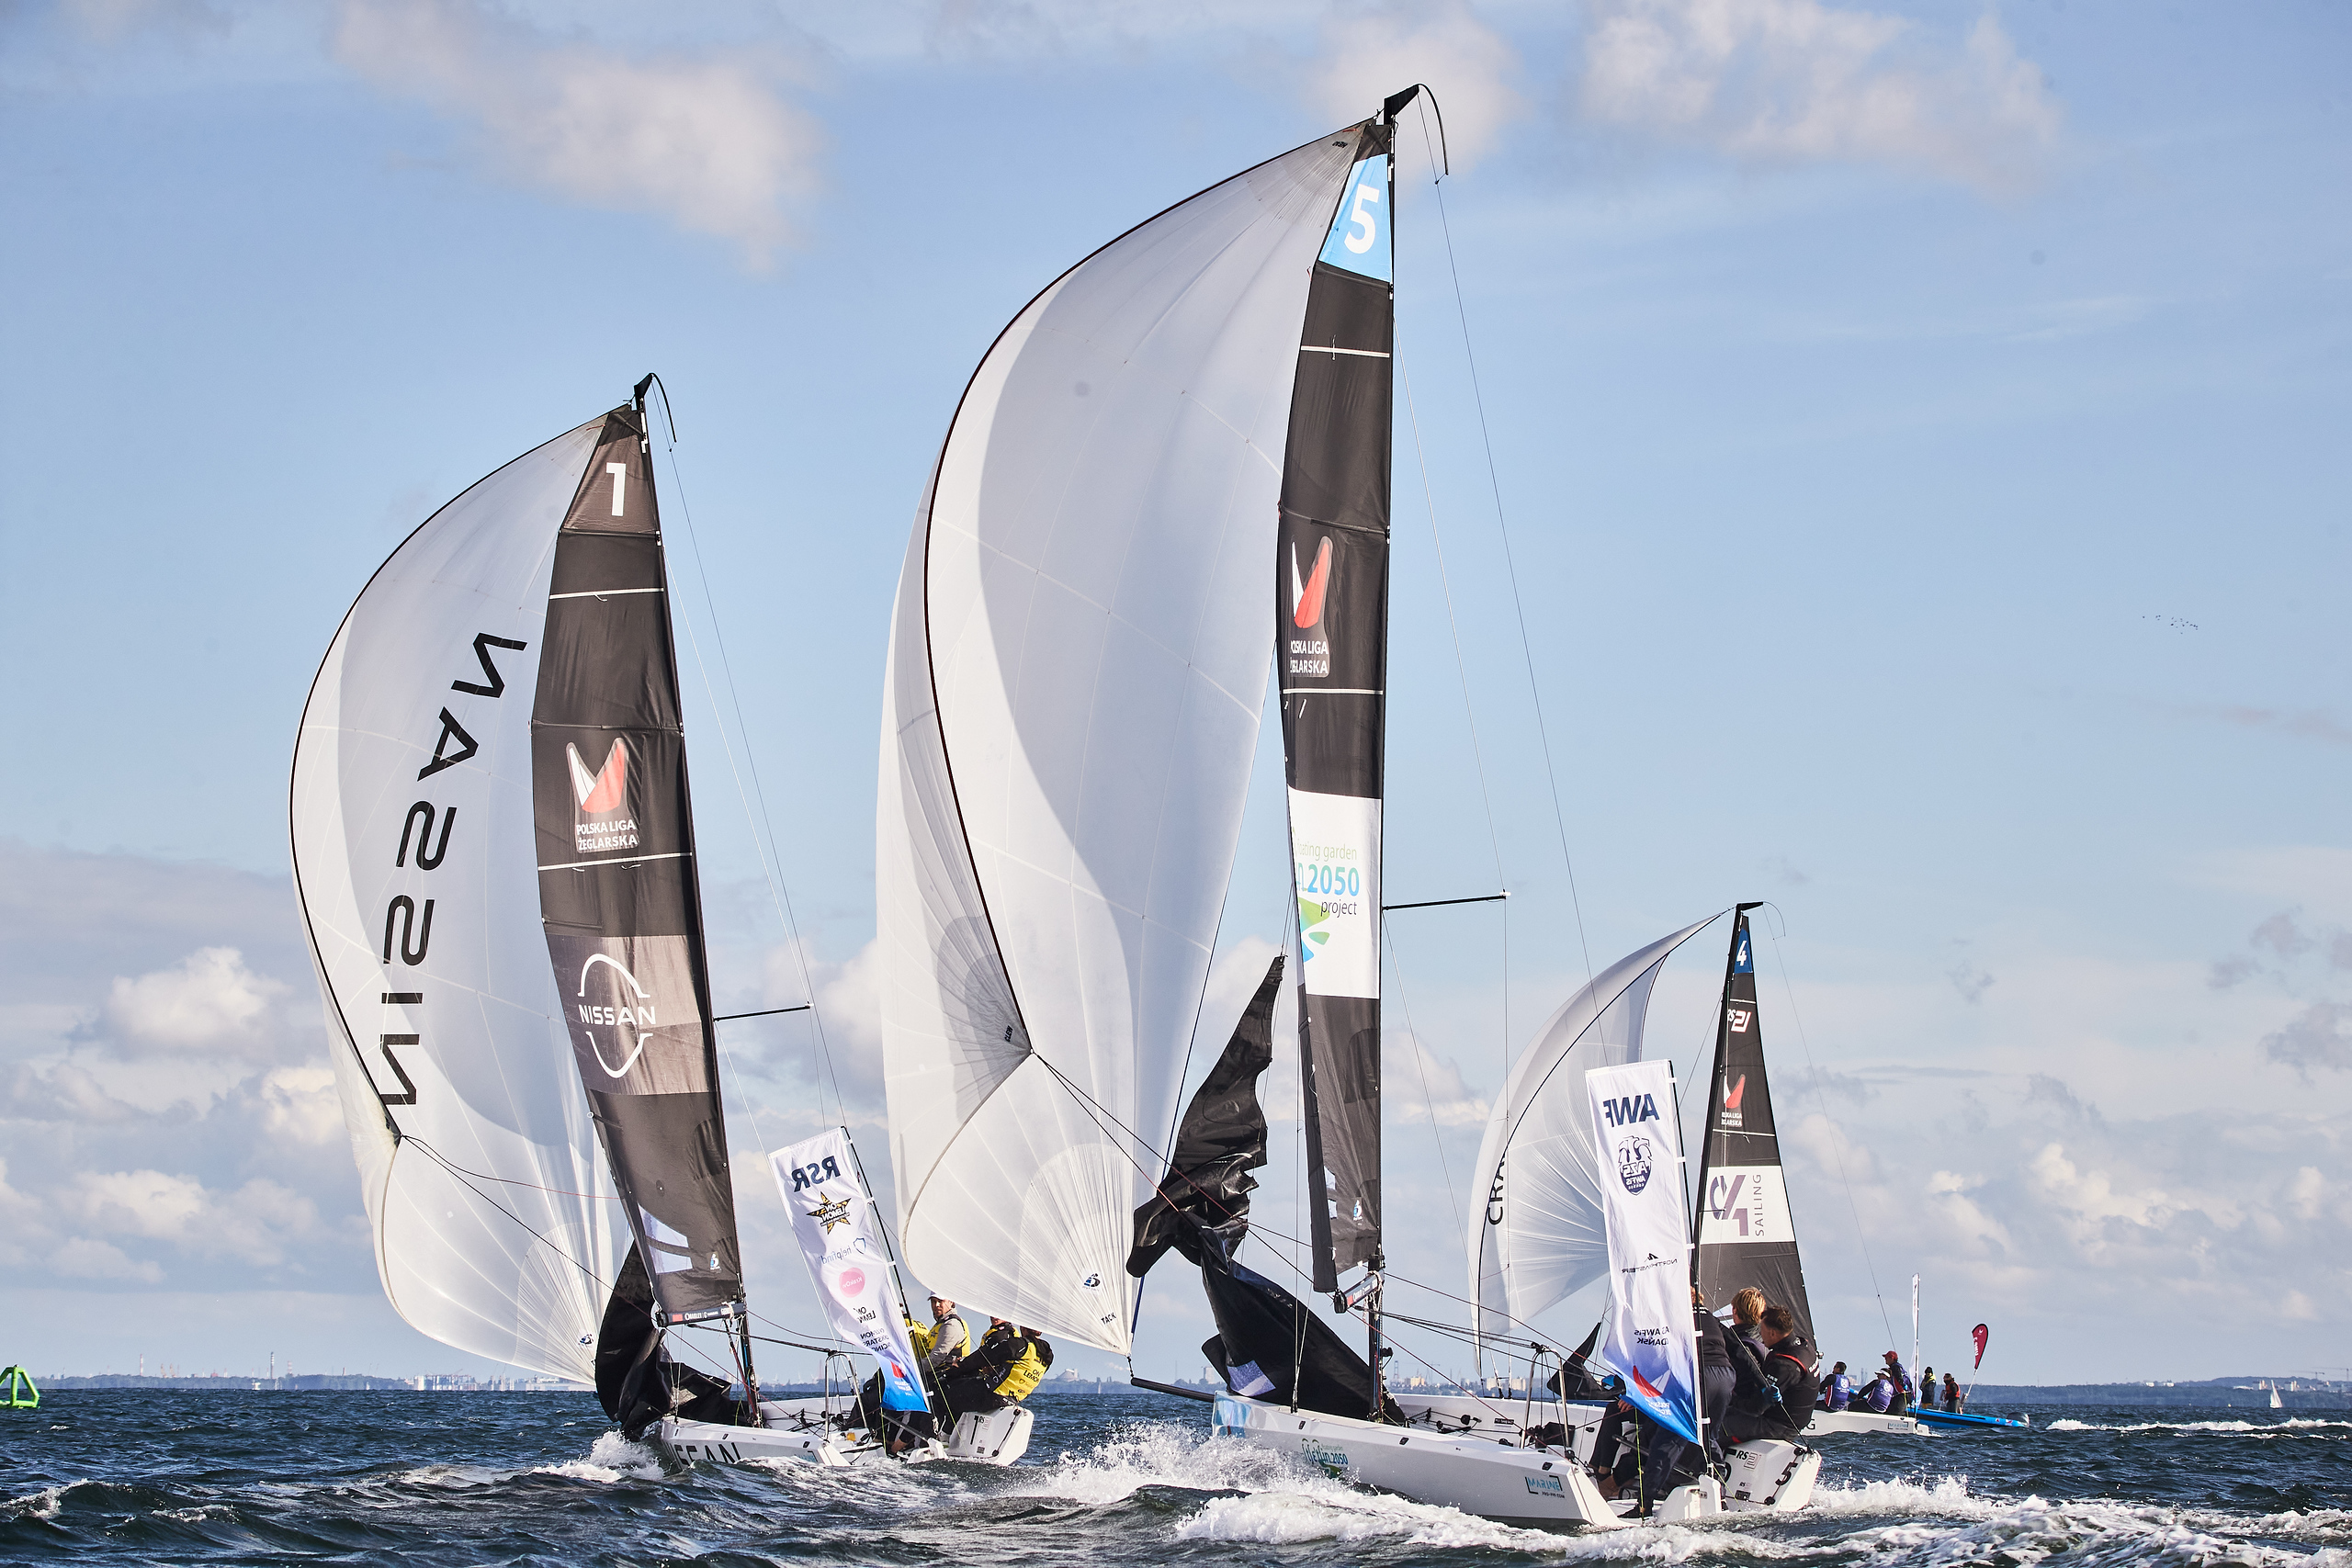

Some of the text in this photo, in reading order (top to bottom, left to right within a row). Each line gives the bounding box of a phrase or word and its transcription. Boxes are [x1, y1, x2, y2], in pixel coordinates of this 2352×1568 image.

[1343, 183, 1380, 254] 5
[605, 462, 627, 517] 1
[1307, 640, 1329, 655] LIGA
[575, 818, 637, 836] POLSKA LIGA
[577, 834, 639, 851] ŻEGLARSKA
[1323, 843, 1357, 863] garden
[1320, 899, 1357, 919] project
[1736, 940, 1747, 967] 4
[578, 1003, 656, 1027] NISSAN
[1752, 1174, 1765, 1237] SAILING
[1101, 1312, 1116, 1325] TACK
[1775, 1462, 1798, 1486] 5
[1526, 1477, 1561, 1492] MARINE
